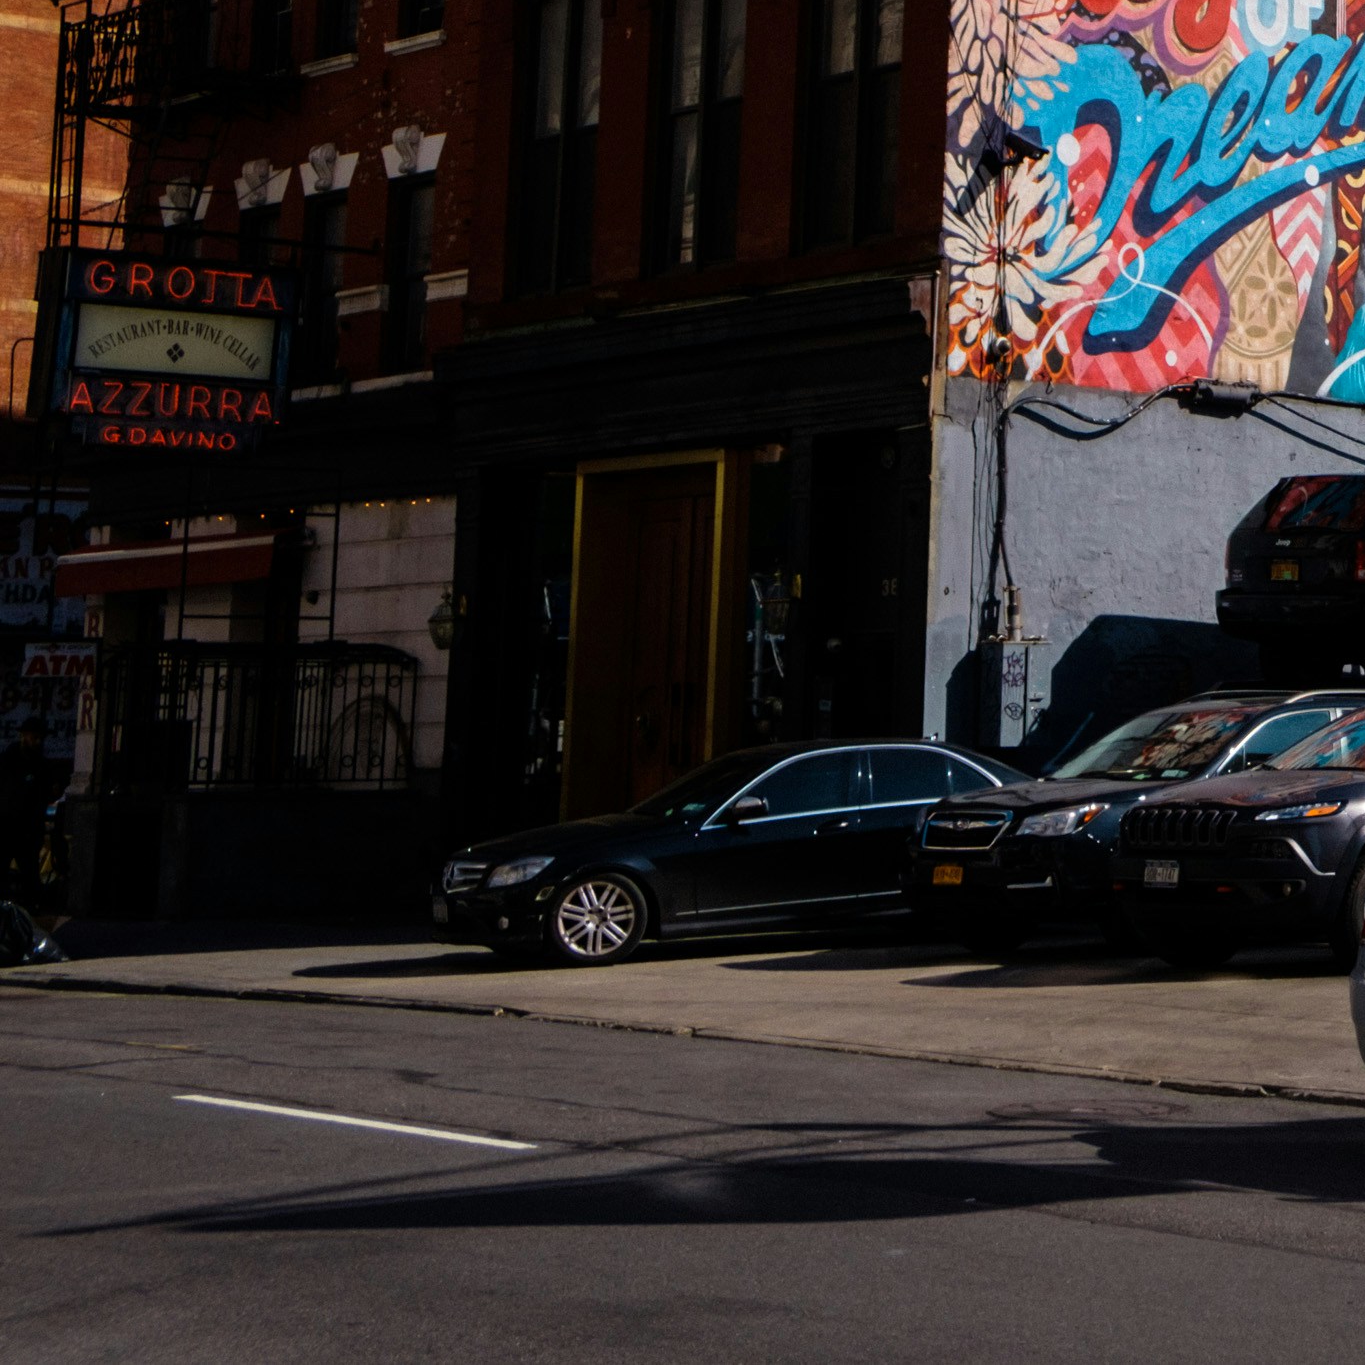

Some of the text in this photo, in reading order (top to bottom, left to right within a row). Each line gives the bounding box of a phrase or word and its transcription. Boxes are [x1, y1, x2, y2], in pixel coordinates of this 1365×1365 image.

[90, 260, 283, 312] GROTTA
[88, 318, 262, 372] RESTAURANT BAR WINE CELLAR
[70, 381, 274, 423] AZZURRA
[25, 654, 94, 676] ATM
